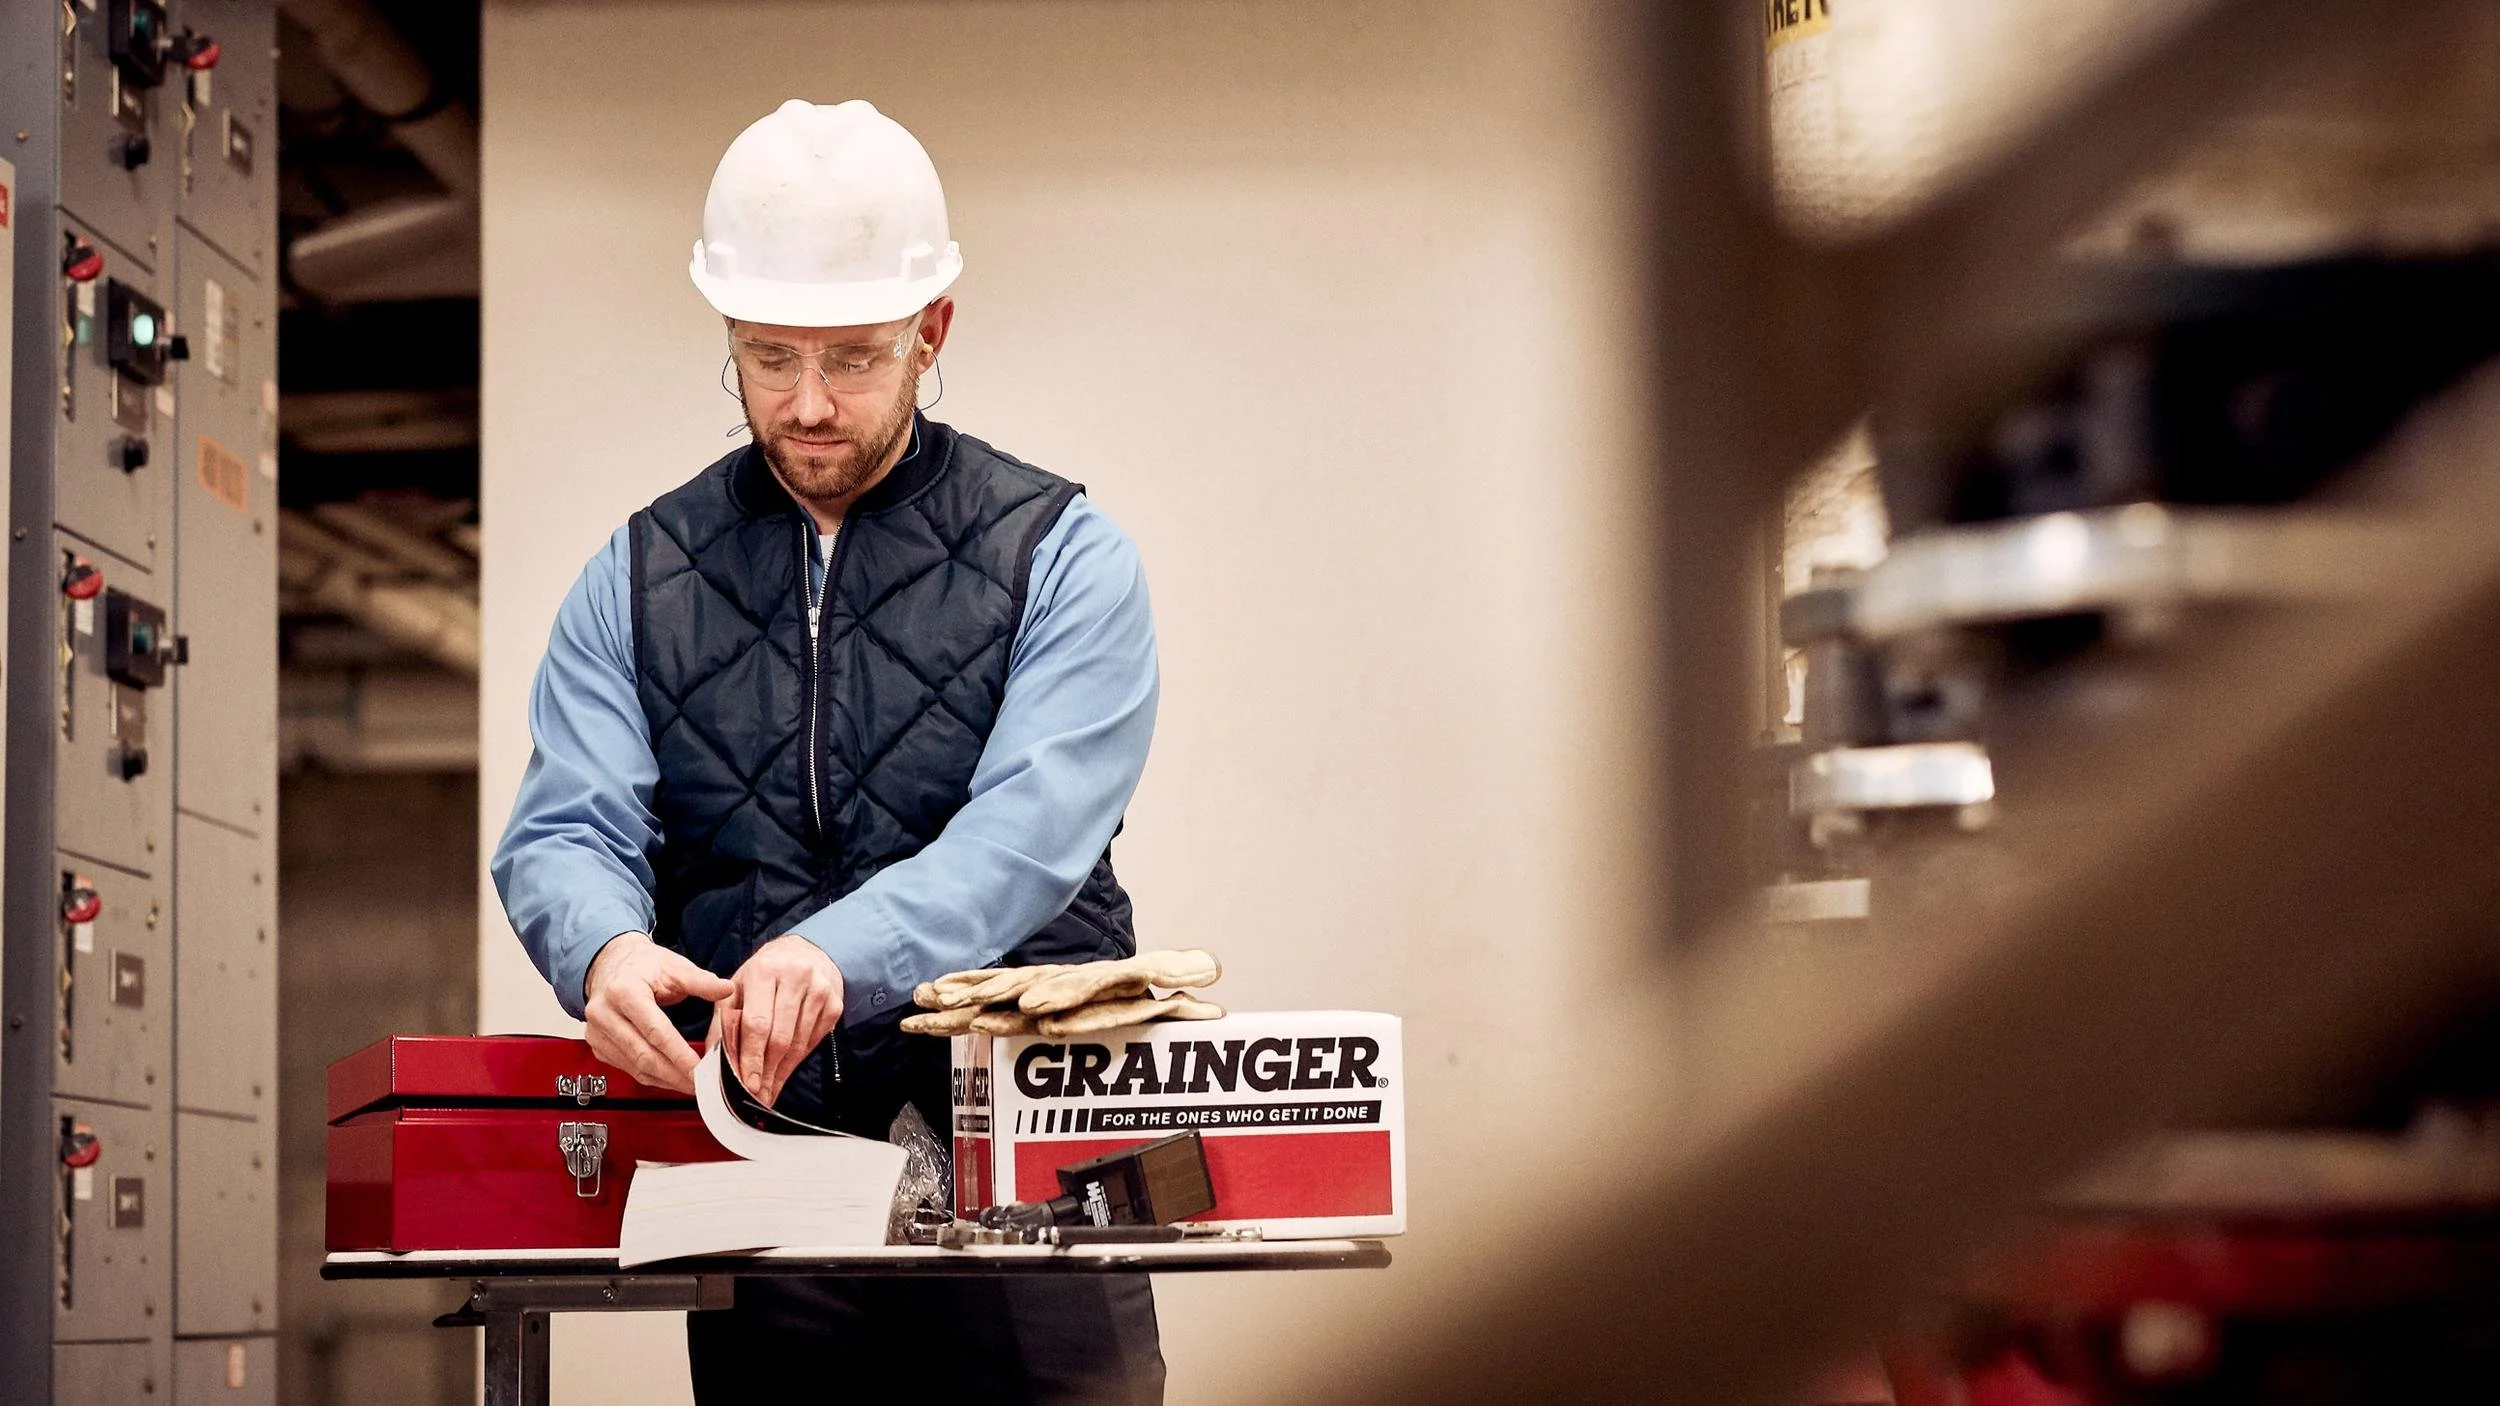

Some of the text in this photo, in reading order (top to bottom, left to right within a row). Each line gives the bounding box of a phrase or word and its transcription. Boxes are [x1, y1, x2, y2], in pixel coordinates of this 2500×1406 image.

[953, 1067, 990, 1106] GRGER
[1102, 1106, 1368, 1126] FOR THE ONES WHO GET IT DONE
